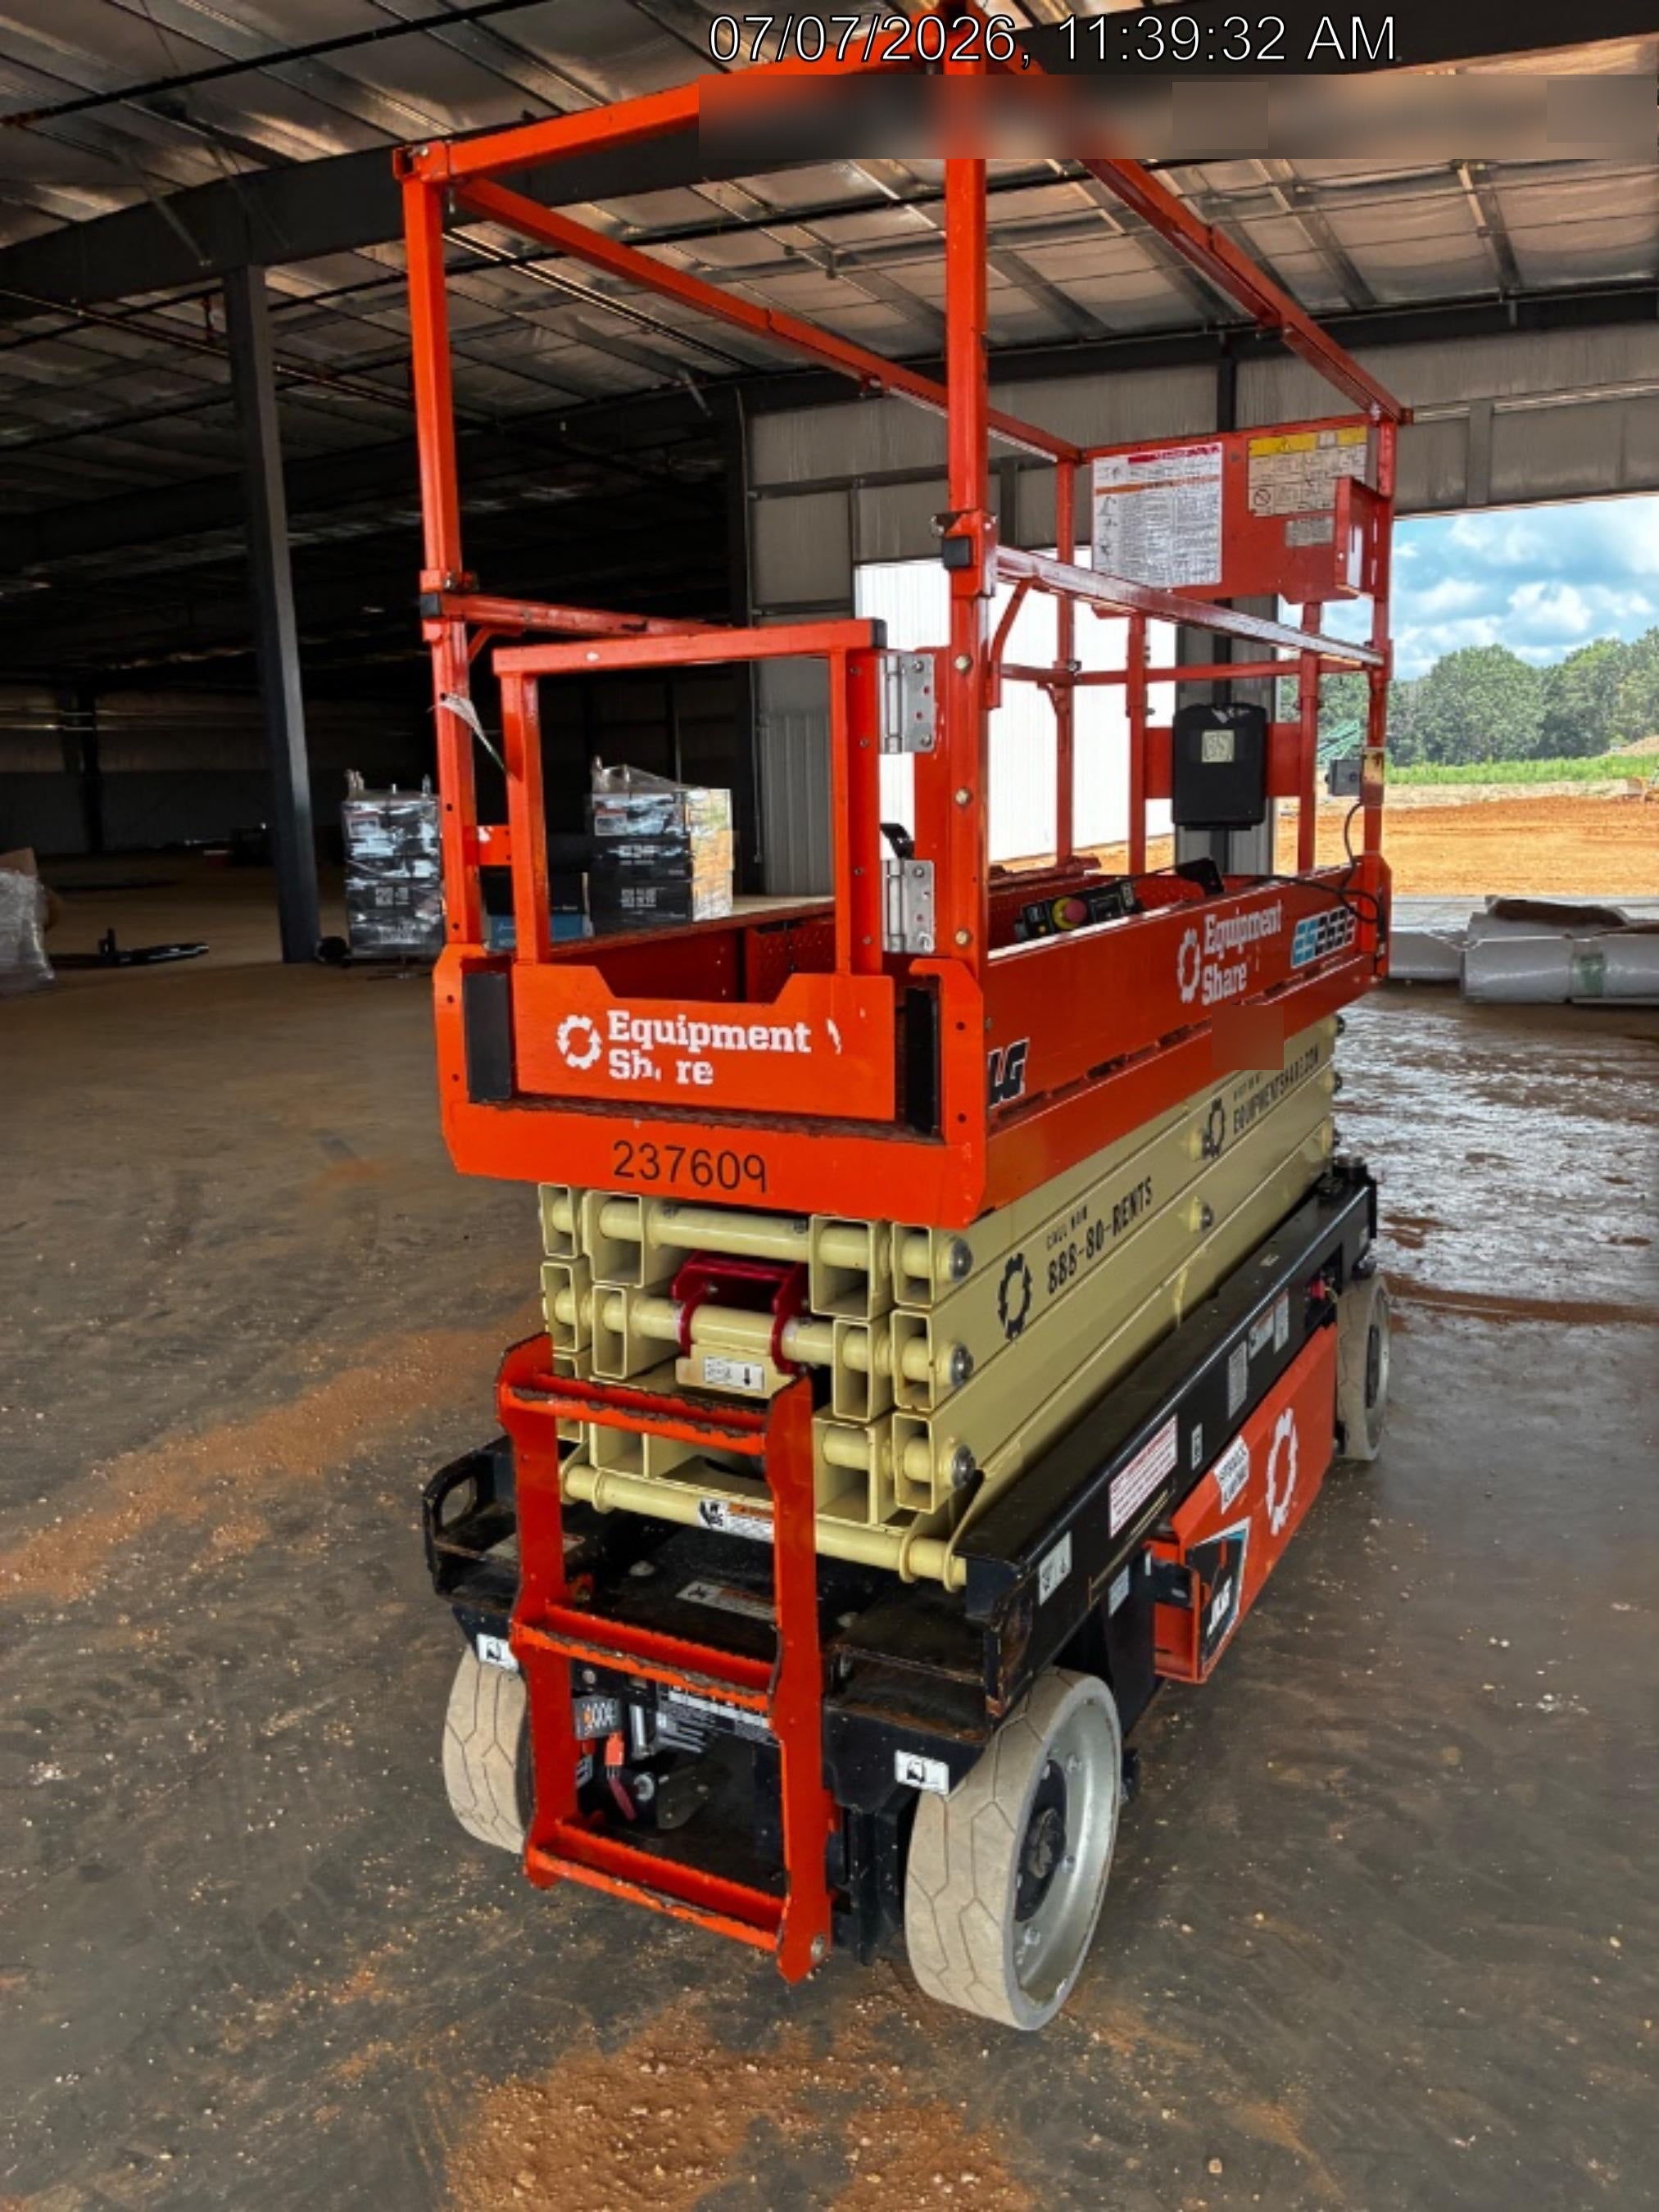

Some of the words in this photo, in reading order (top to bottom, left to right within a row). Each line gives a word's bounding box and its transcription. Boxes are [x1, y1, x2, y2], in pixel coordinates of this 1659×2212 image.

[1204, 899, 1281, 961] Equipment
[1202, 962, 1248, 1006] Share
[606, 1009, 812, 1054] Equipment
[609, 1048, 714, 1086] Shre
[987, 1036, 1031, 1110] LG
[613, 1140, 767, 1194] 237609
